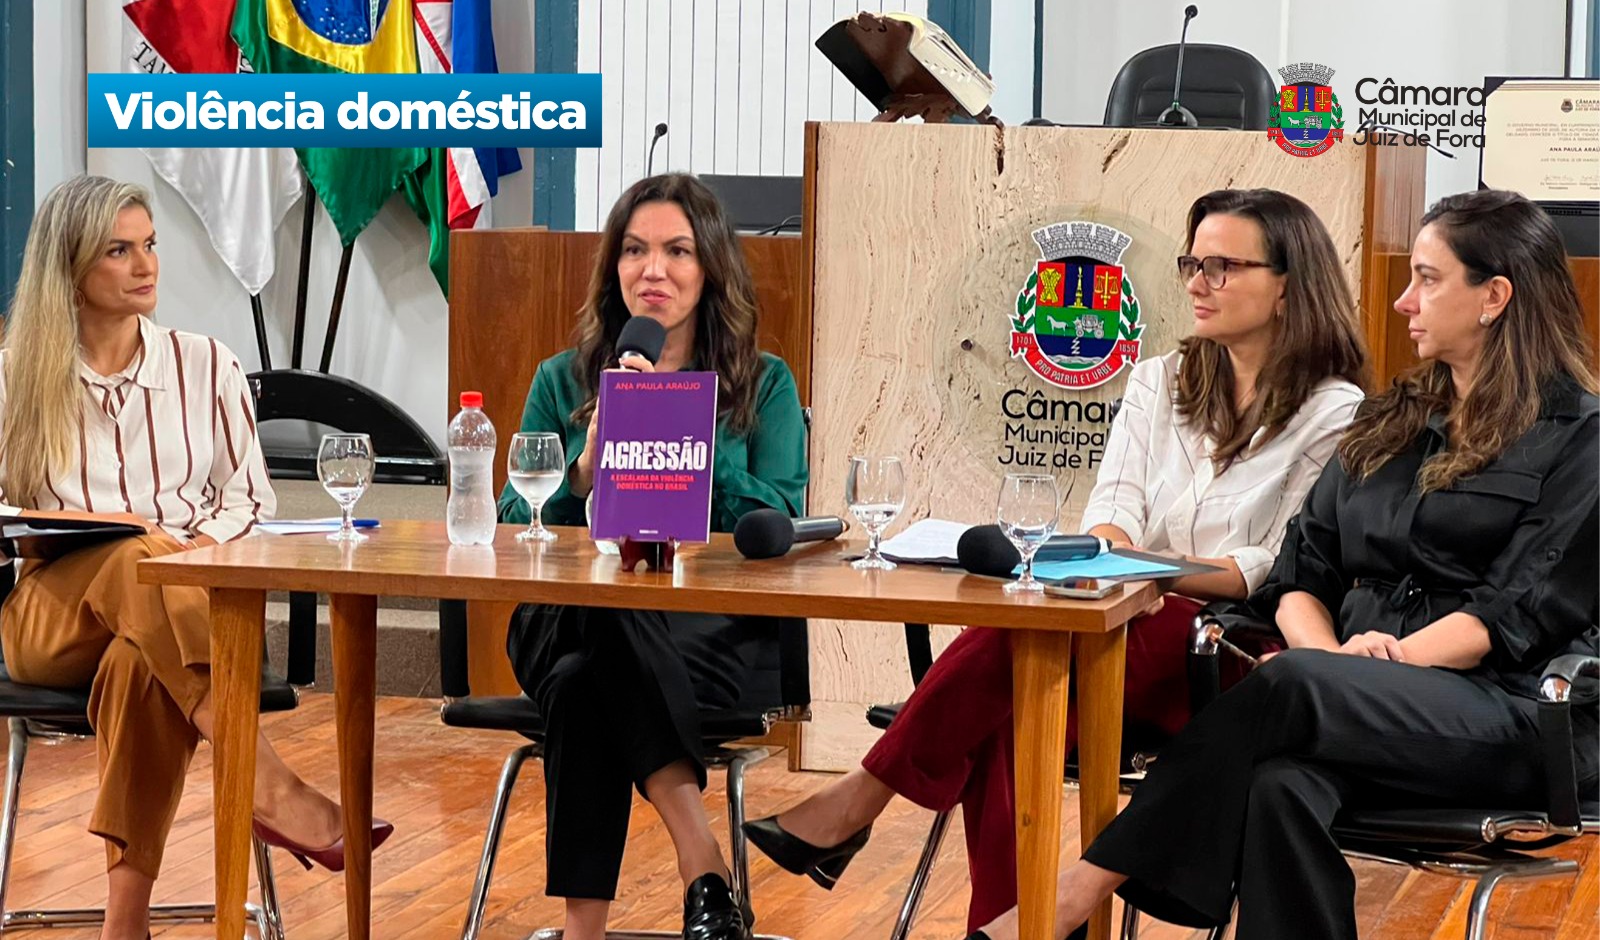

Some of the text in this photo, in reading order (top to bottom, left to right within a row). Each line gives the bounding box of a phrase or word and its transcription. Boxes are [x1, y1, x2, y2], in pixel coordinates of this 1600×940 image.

[1016, 336, 1032, 345] 1701
[1120, 342, 1136, 353] 1850
[1035, 359, 1113, 385] PRO PATRIA ET URBE
[615, 381, 701, 390] ANA PAULA ARAÚJO
[600, 436, 708, 471] AGRESSÃO
[997, 445, 1047, 467] Juiz
[1053, 448, 1082, 469] de
